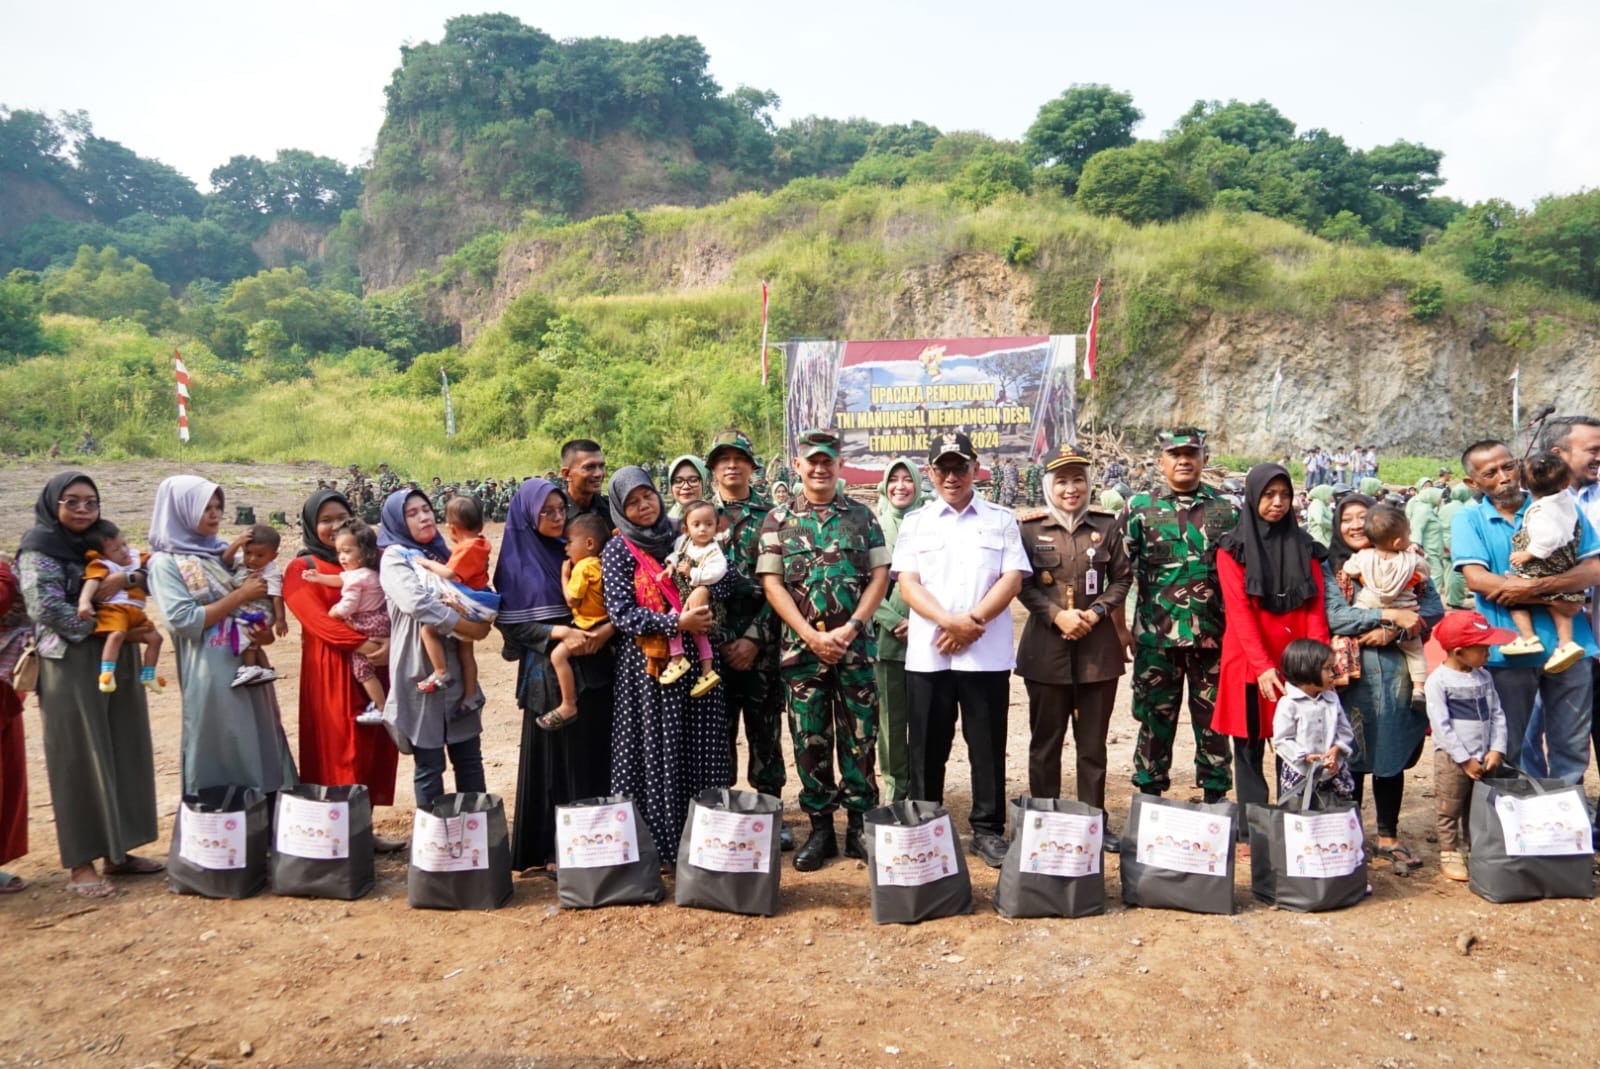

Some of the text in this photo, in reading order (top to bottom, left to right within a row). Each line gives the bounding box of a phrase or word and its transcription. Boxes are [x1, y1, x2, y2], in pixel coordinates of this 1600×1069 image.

[872, 384, 994, 403] UPACARA PEMBUKAAN
[837, 406, 1031, 429] TNI MANUNGGAL MEMBANGUN DESA
[869, 434, 912, 451] (TMMD)
[971, 431, 999, 448] 2024
